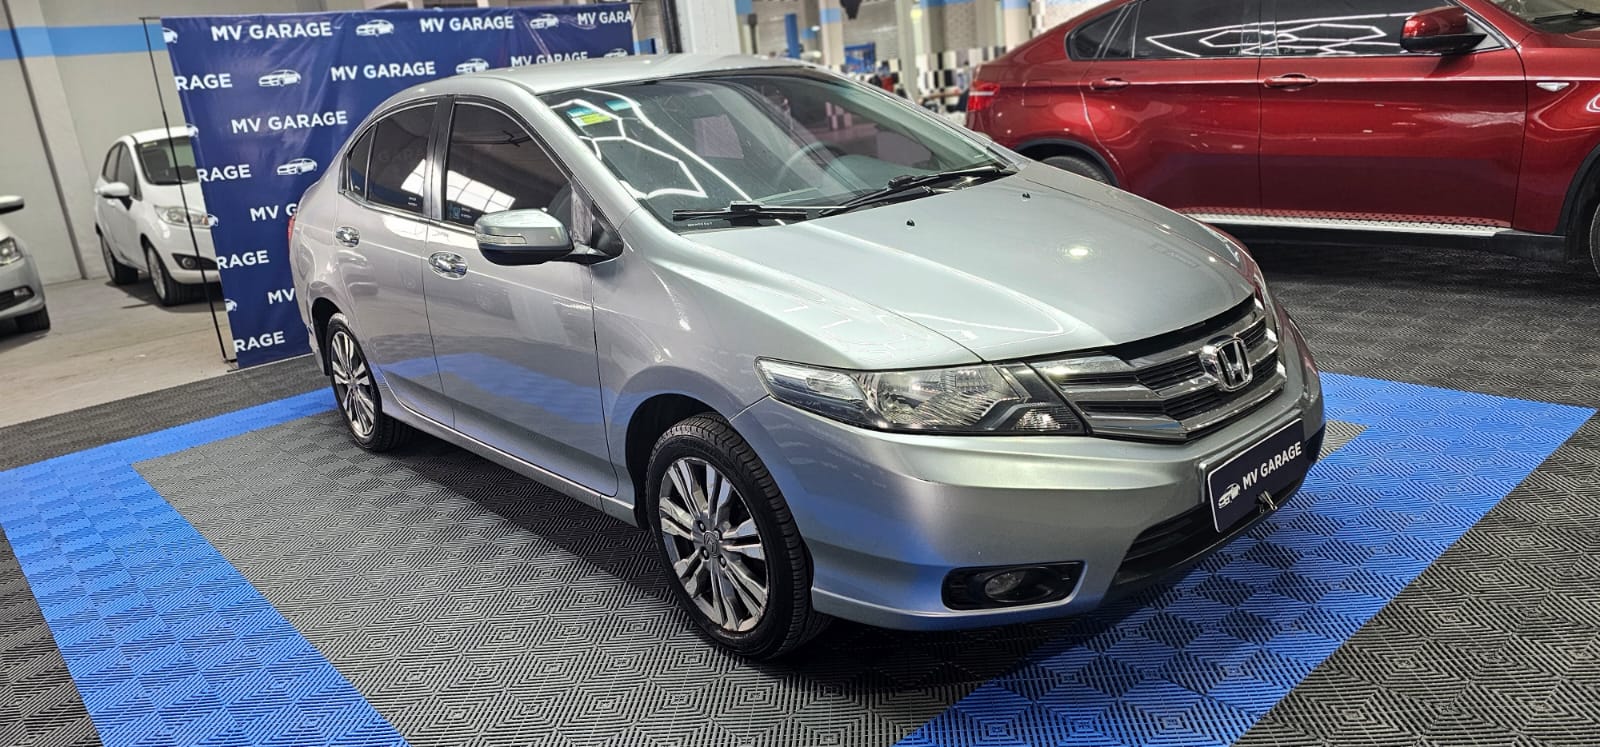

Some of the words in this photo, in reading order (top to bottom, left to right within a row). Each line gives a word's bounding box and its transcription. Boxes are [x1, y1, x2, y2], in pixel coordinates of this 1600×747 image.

[420, 17, 445, 32] MV
[449, 16, 515, 31] GARAGE
[577, 11, 597, 25] MV
[210, 25, 242, 41] MV
[249, 22, 333, 39] GARAGE
[510, 55, 532, 68] MV
[536, 51, 588, 64] GARAGE
[330, 65, 358, 81] MV
[363, 61, 436, 79] GARAGE
[231, 118, 261, 134] MV
[268, 110, 348, 131] GARAGE
[250, 205, 279, 222] MV
[267, 287, 295, 304] MV
[1242, 468, 1258, 490] MV
[1260, 441, 1303, 478] GARAGE
